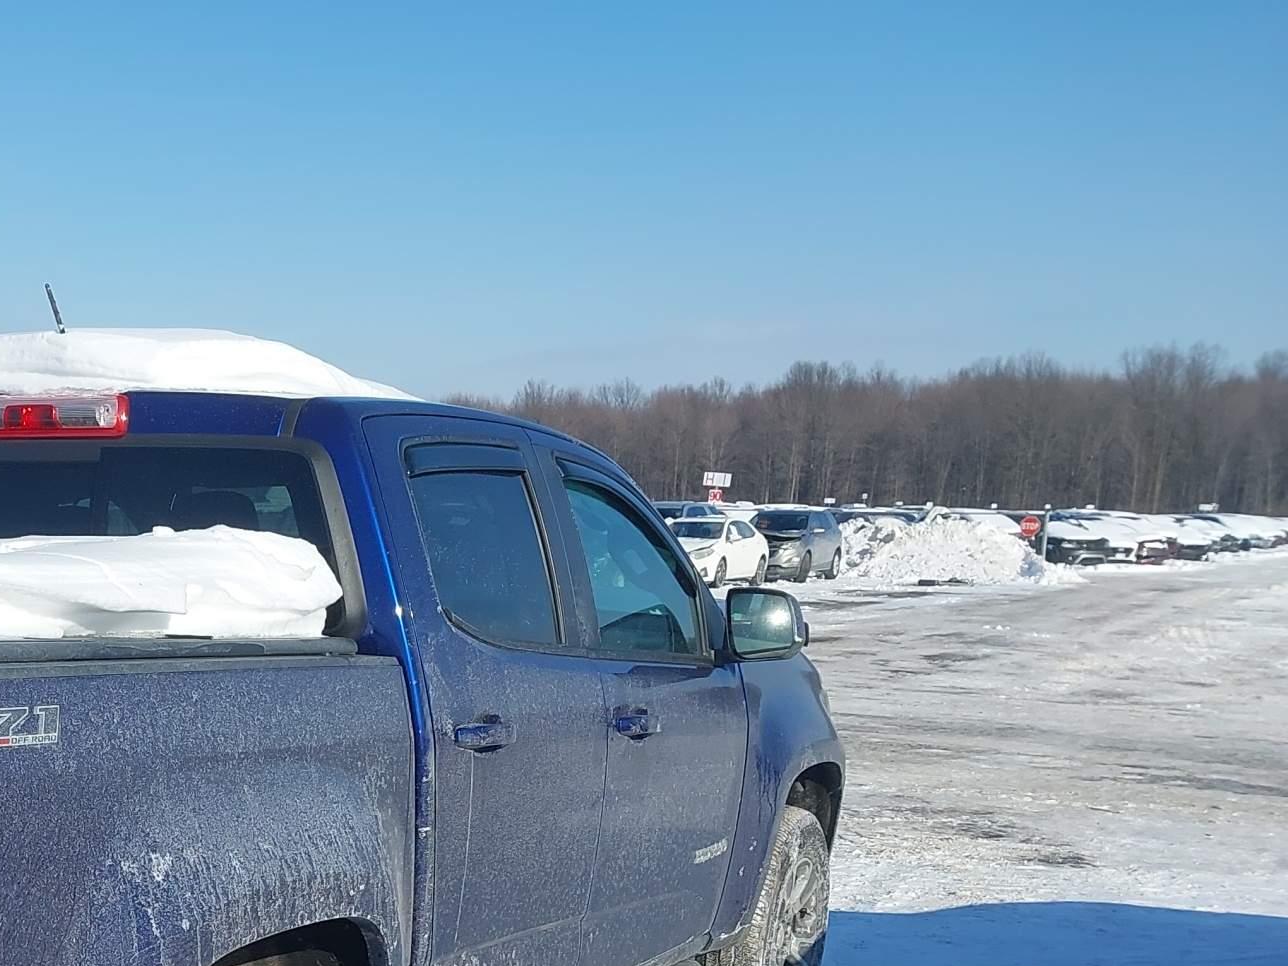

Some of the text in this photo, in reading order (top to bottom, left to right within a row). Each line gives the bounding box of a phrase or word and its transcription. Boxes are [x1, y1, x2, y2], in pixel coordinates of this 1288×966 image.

[709, 491, 722, 501] 90
[1021, 521, 1040, 531] STOP
[11, 734, 58, 745] OFF ROAD
